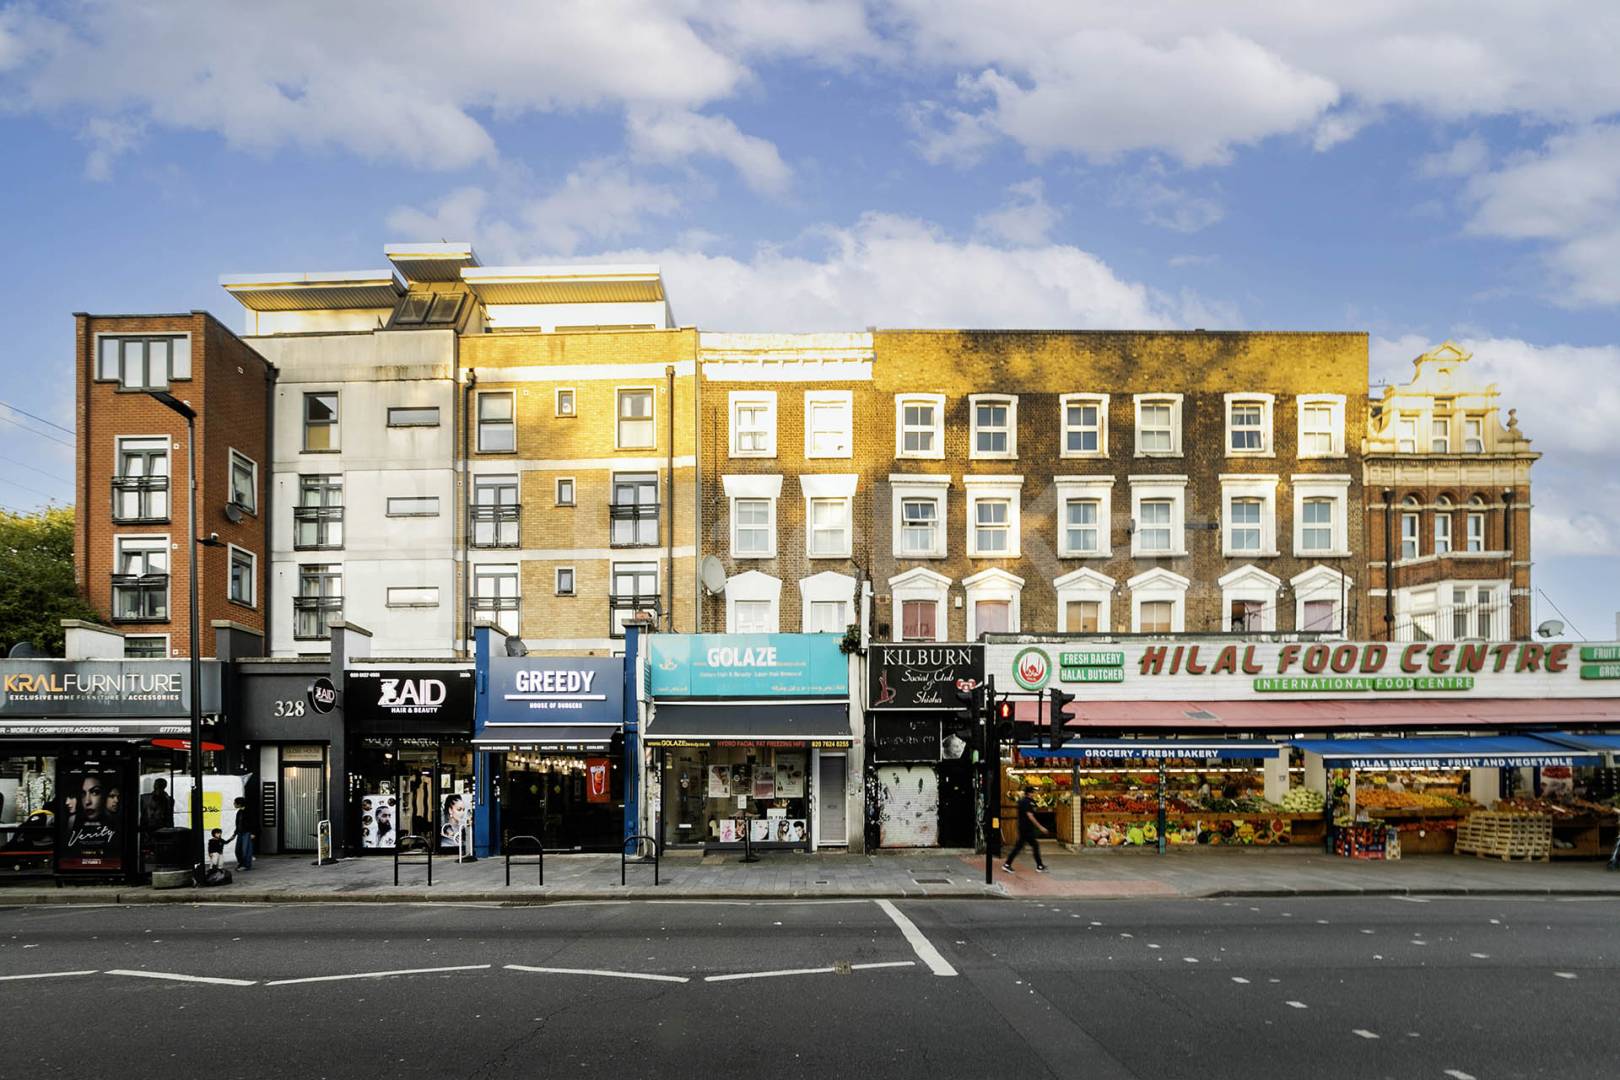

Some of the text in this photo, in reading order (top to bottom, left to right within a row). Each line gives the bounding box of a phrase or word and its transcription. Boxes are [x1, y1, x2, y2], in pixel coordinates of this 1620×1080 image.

[706, 646, 777, 668] GOLAZE
[883, 649, 972, 666] KILBURN
[1064, 653, 1121, 664] FRESH BAKERY
[1138, 643, 1573, 675] HILAL FOOD CENTRE
[1593, 647, 1615, 659] FRUIT
[515, 670, 596, 692] GREEDY
[901, 669, 954, 682] Social Club
[1061, 669, 1123, 680] HALAL BUTCHER
[1256, 678, 1474, 690] INTERNATIONAL FOOD CENTRE
[378, 678, 447, 705] ZAID
[912, 691, 943, 704] Shisha
[273, 700, 305, 717] 328
[1085, 749, 1135, 759] GROCERY
[1141, 749, 1175, 758] FRESH
[1177, 749, 1218, 758] BAKERY
[1352, 759, 1388, 768] HALAL
[1389, 759, 1440, 768] BUTCHER
[1446, 758, 1481, 767] FRUIT
[1483, 758, 1506, 767] AND
[1508, 757, 1573, 766] VEGETABLE
[68, 825, 115, 847] Verity
